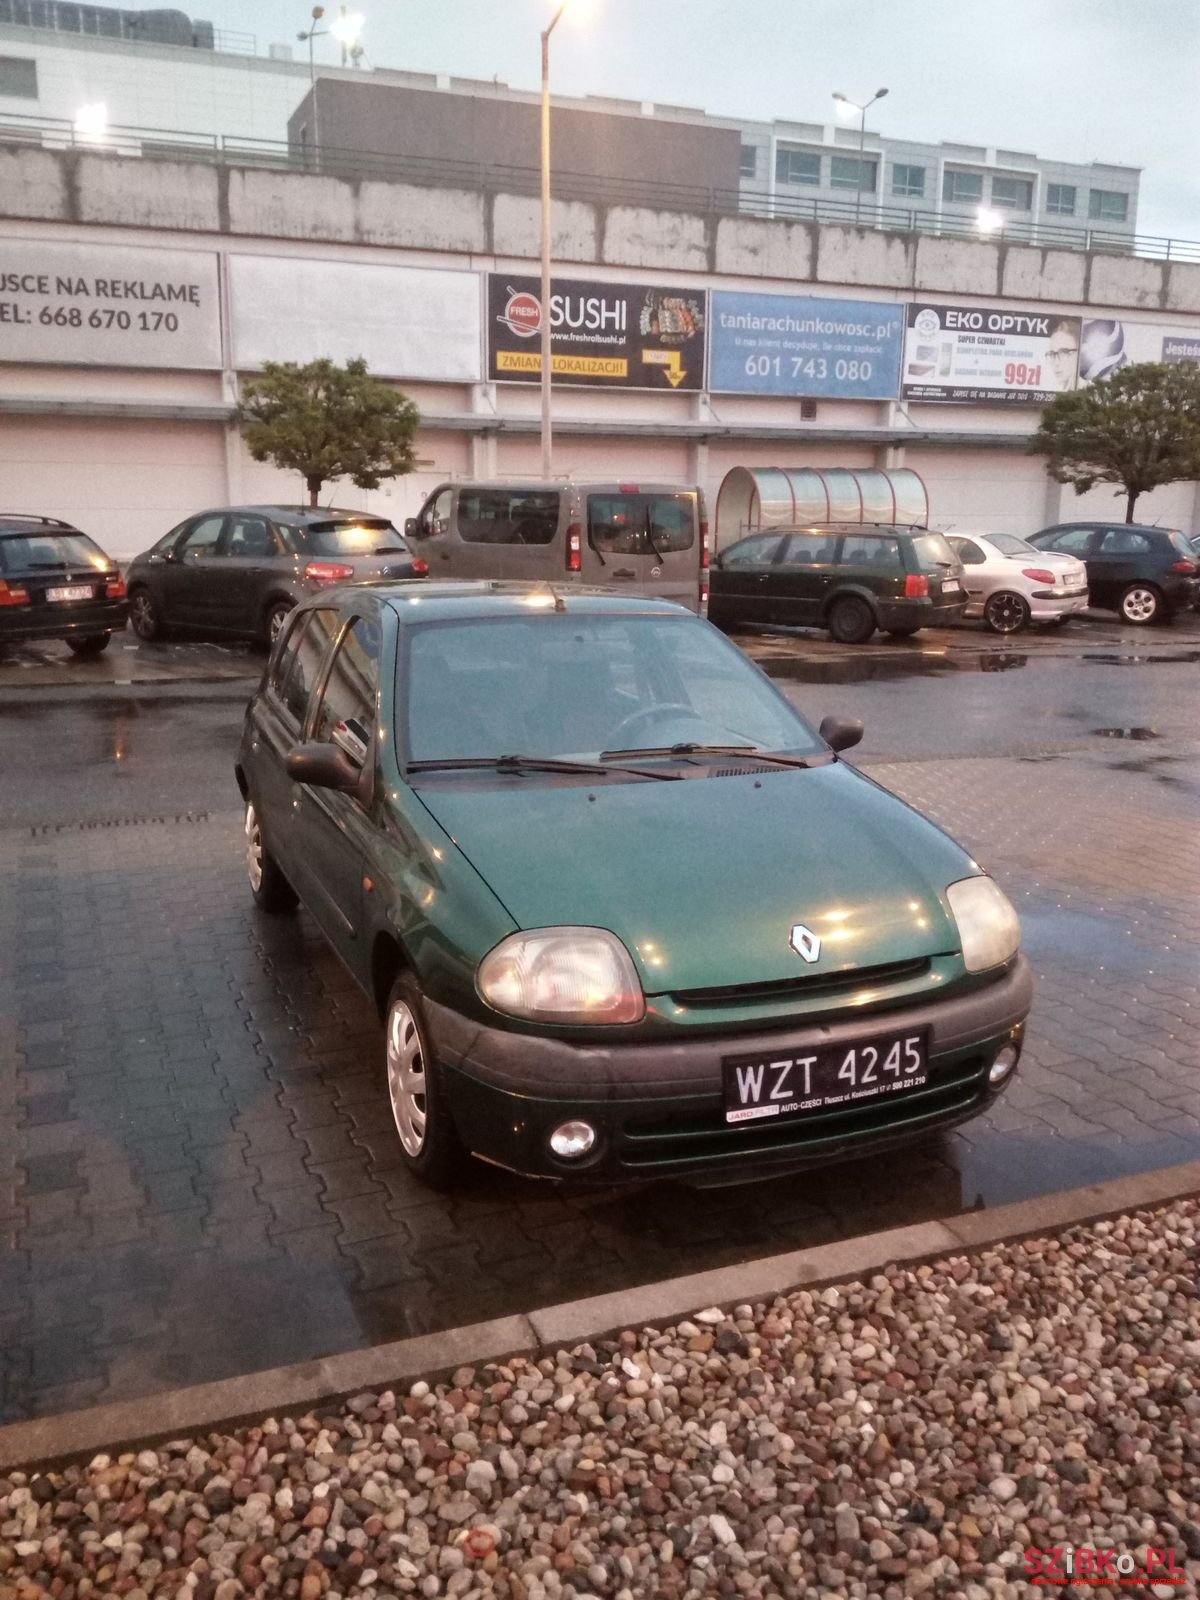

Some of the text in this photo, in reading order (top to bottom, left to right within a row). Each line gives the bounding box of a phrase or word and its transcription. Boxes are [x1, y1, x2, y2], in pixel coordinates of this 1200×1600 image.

[56, 277, 89, 296] NA
[95, 279, 200, 307] REKLAMĘ
[39, 306, 82, 327] 668
[88, 309, 131, 330] 670
[138, 312, 178, 332] 170
[511, 306, 538, 317] FRESH
[550, 295, 627, 331] SUSHI
[945, 311, 1049, 334] EKO OPTYK
[720, 312, 891, 340] taniarachunkowosc.pl
[958, 335, 975, 344] SUPER
[502, 355, 623, 374] ZMIAN LOKALIZACJI!
[745, 355, 872, 381] 601 743 080
[736, 1037, 920, 1104] WZT 4245
